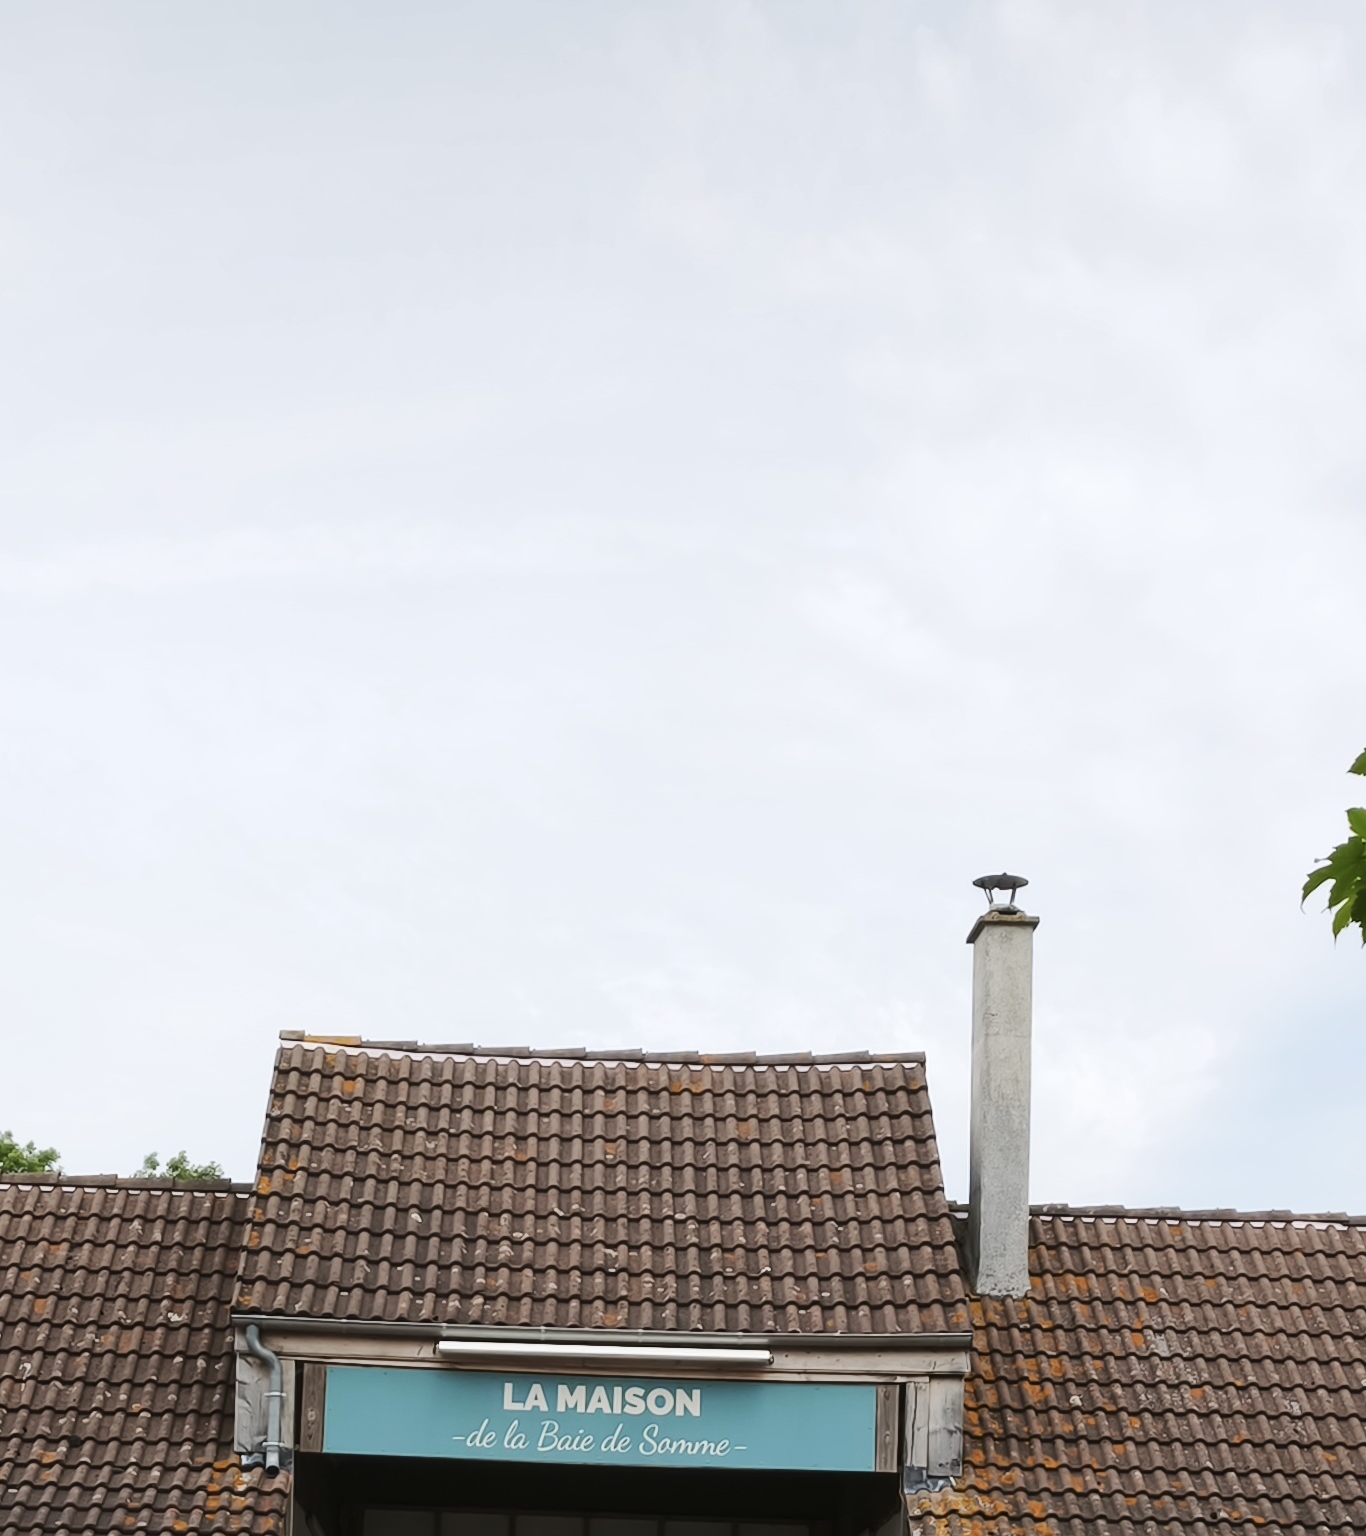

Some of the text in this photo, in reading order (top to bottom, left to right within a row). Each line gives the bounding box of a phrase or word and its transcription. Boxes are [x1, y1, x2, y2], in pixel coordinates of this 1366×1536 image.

[503, 1382, 701, 1418] LA MAISON
[503, 1419, 530, 1450] la
[537, 1420, 596, 1452] Baie
[600, 1423, 633, 1453] de
